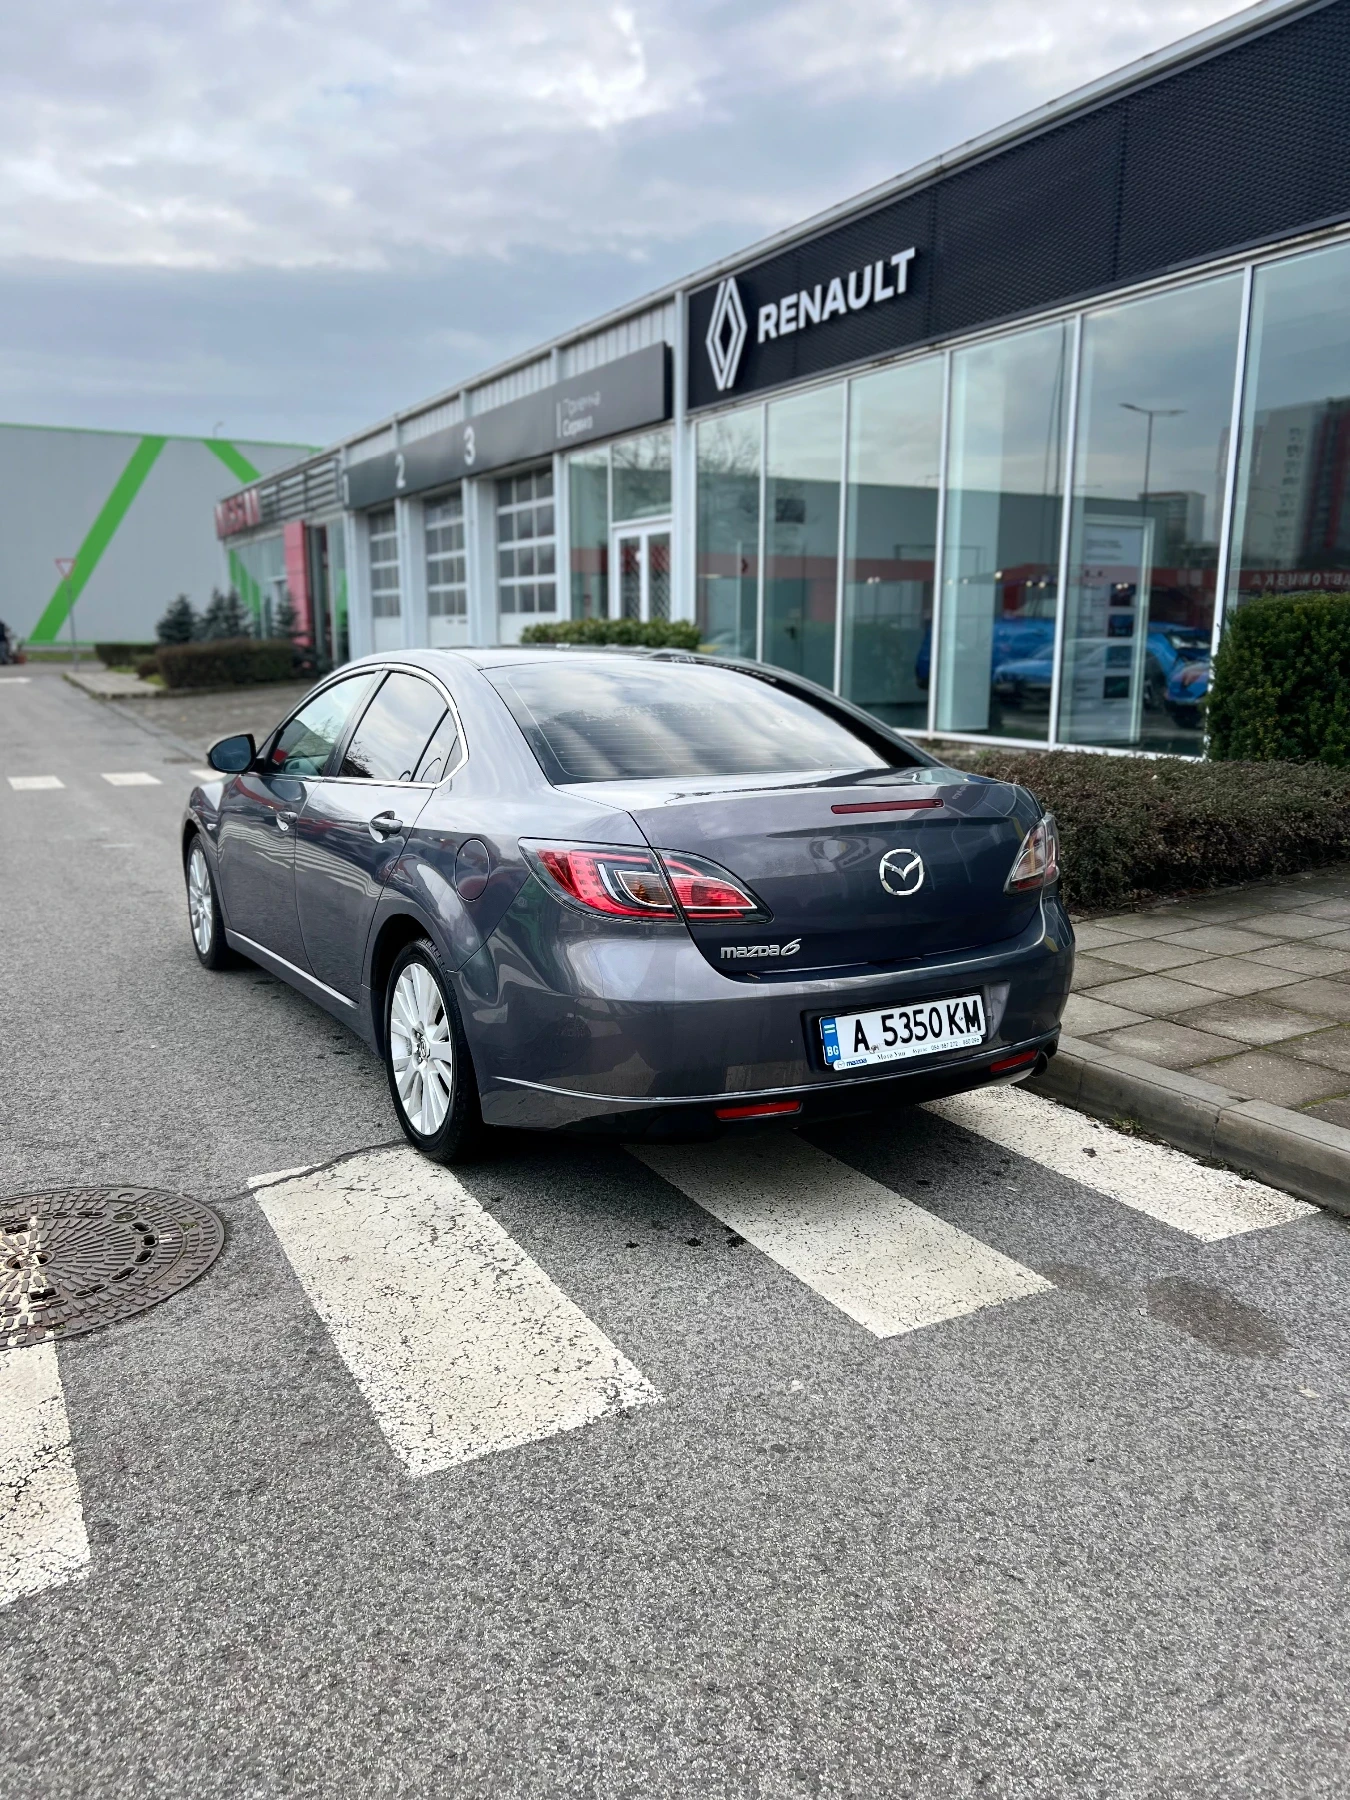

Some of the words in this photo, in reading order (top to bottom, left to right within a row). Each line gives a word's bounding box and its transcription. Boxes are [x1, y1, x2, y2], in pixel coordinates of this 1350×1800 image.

[758, 246, 916, 344] RENAULT
[463, 426, 476, 466] 3
[394, 453, 407, 489] 2
[853, 1019, 871, 1053] A
[880, 1006, 943, 1047] 5350
[946, 999, 982, 1036] KM
[826, 1045, 840, 1057] BG
